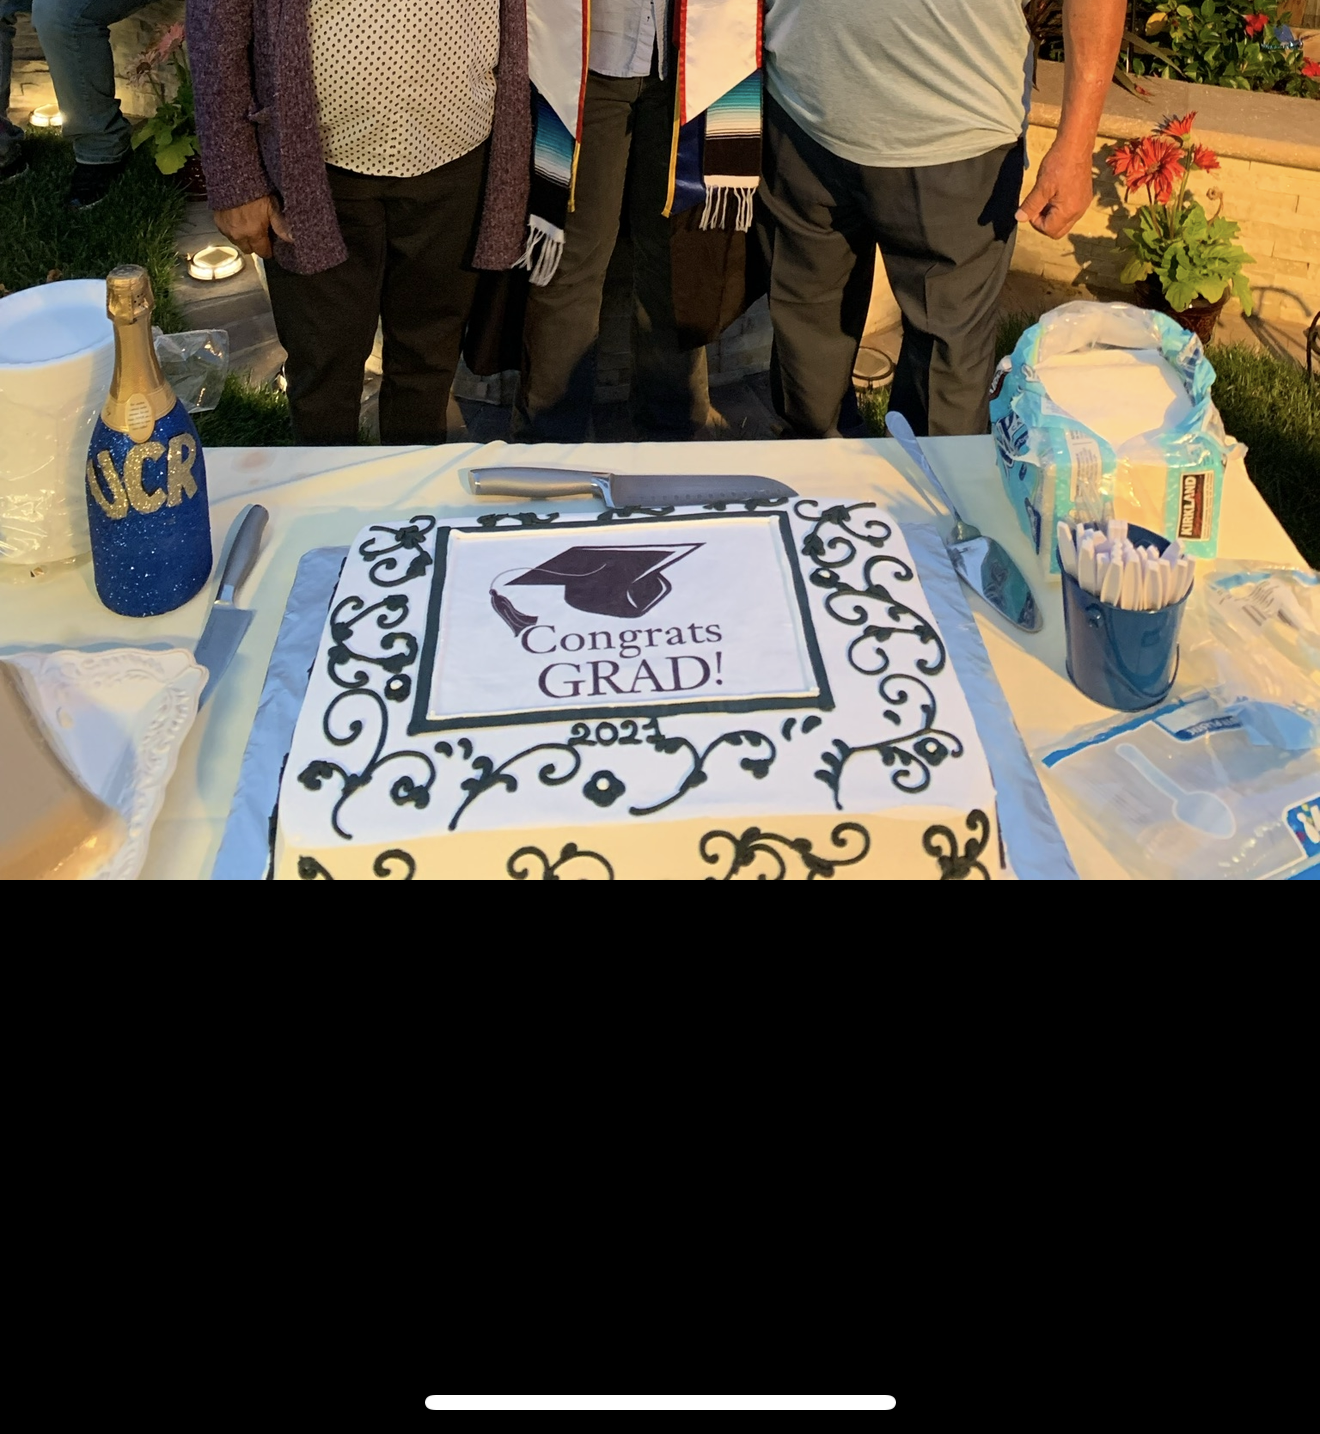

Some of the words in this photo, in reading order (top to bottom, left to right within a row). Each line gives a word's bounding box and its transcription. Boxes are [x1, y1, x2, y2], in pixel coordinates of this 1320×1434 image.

[87, 433, 198, 520] UCR
[1180, 475, 1197, 536] KIRKLAND
[521, 622, 723, 659] Congrats
[538, 651, 723, 698] GRAD!
[567, 717, 666, 747] 2021
